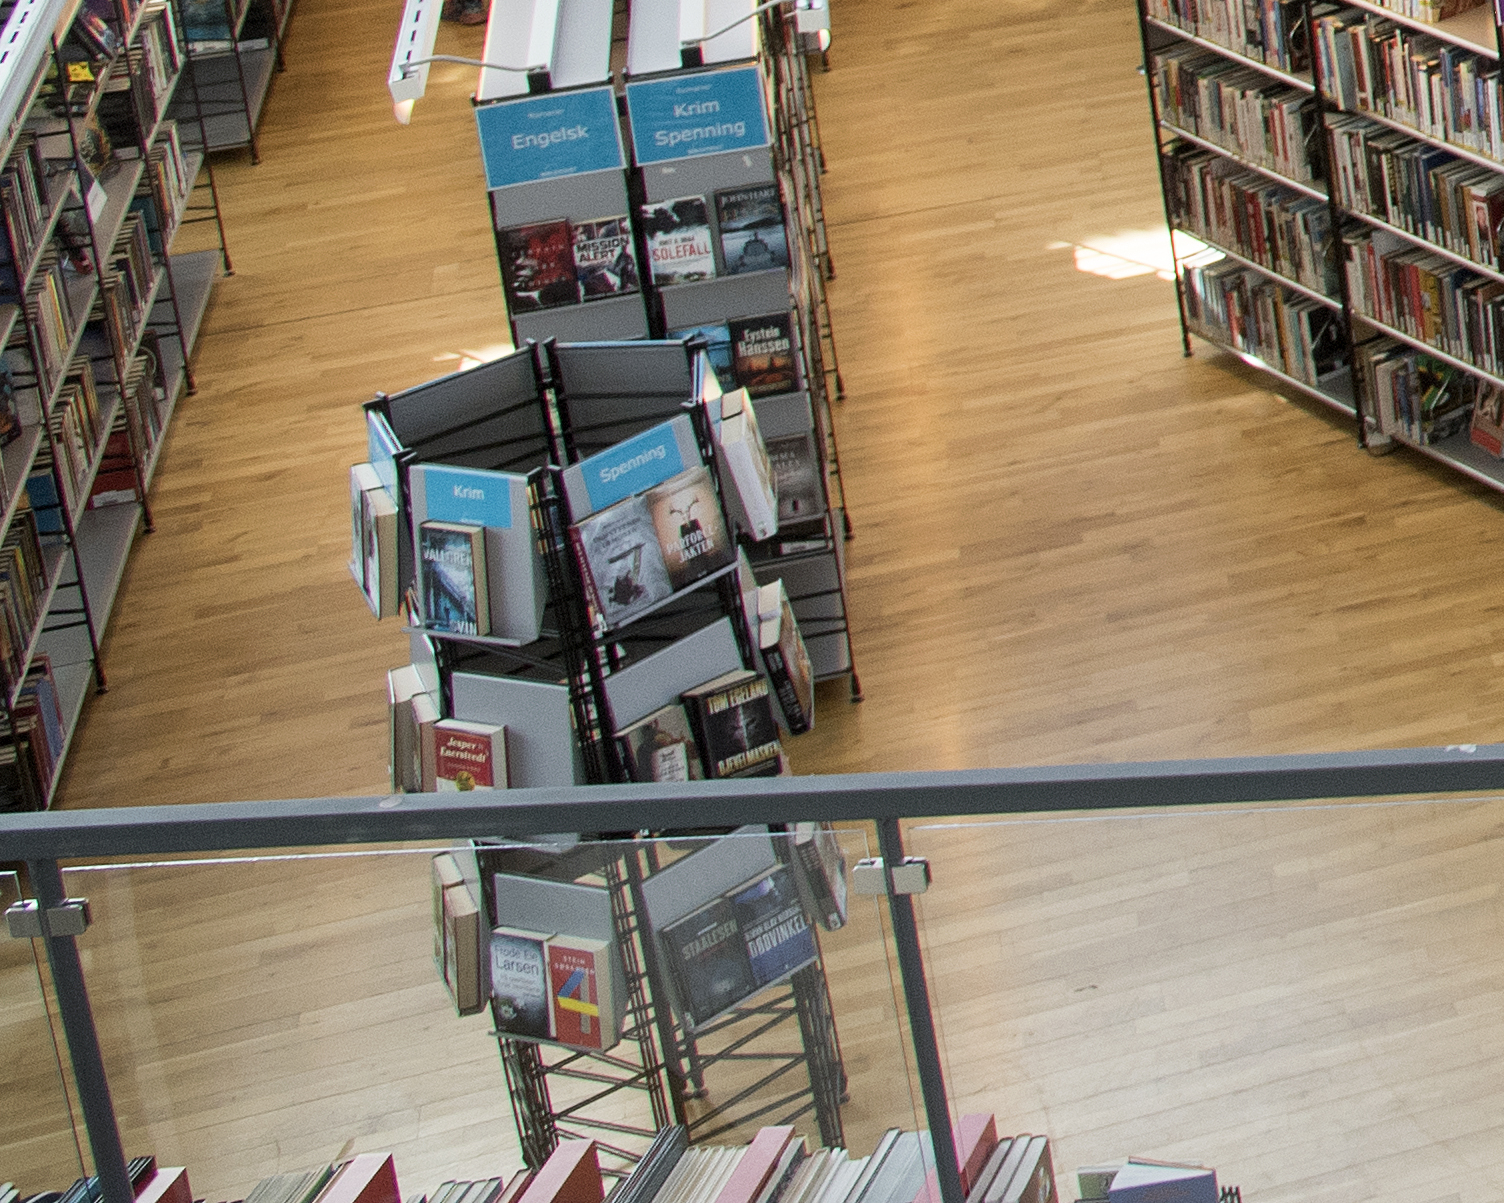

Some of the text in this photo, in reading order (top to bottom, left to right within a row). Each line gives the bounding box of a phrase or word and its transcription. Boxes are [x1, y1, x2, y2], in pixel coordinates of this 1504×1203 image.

[673, 99, 721, 119] Krim
[511, 124, 590, 151] Engelsk
[654, 118, 747, 148] Spenning
[576, 235, 630, 253] MISSION
[652, 239, 711, 263] SOLEFALL
[578, 249, 616, 264] ALERT
[742, 324, 781, 344] Eystein
[738, 336, 791, 357] Hanssen
[599, 443, 668, 484] Spenning
[453, 484, 485, 501] Krim
[494, 954, 541, 977] Larsen
